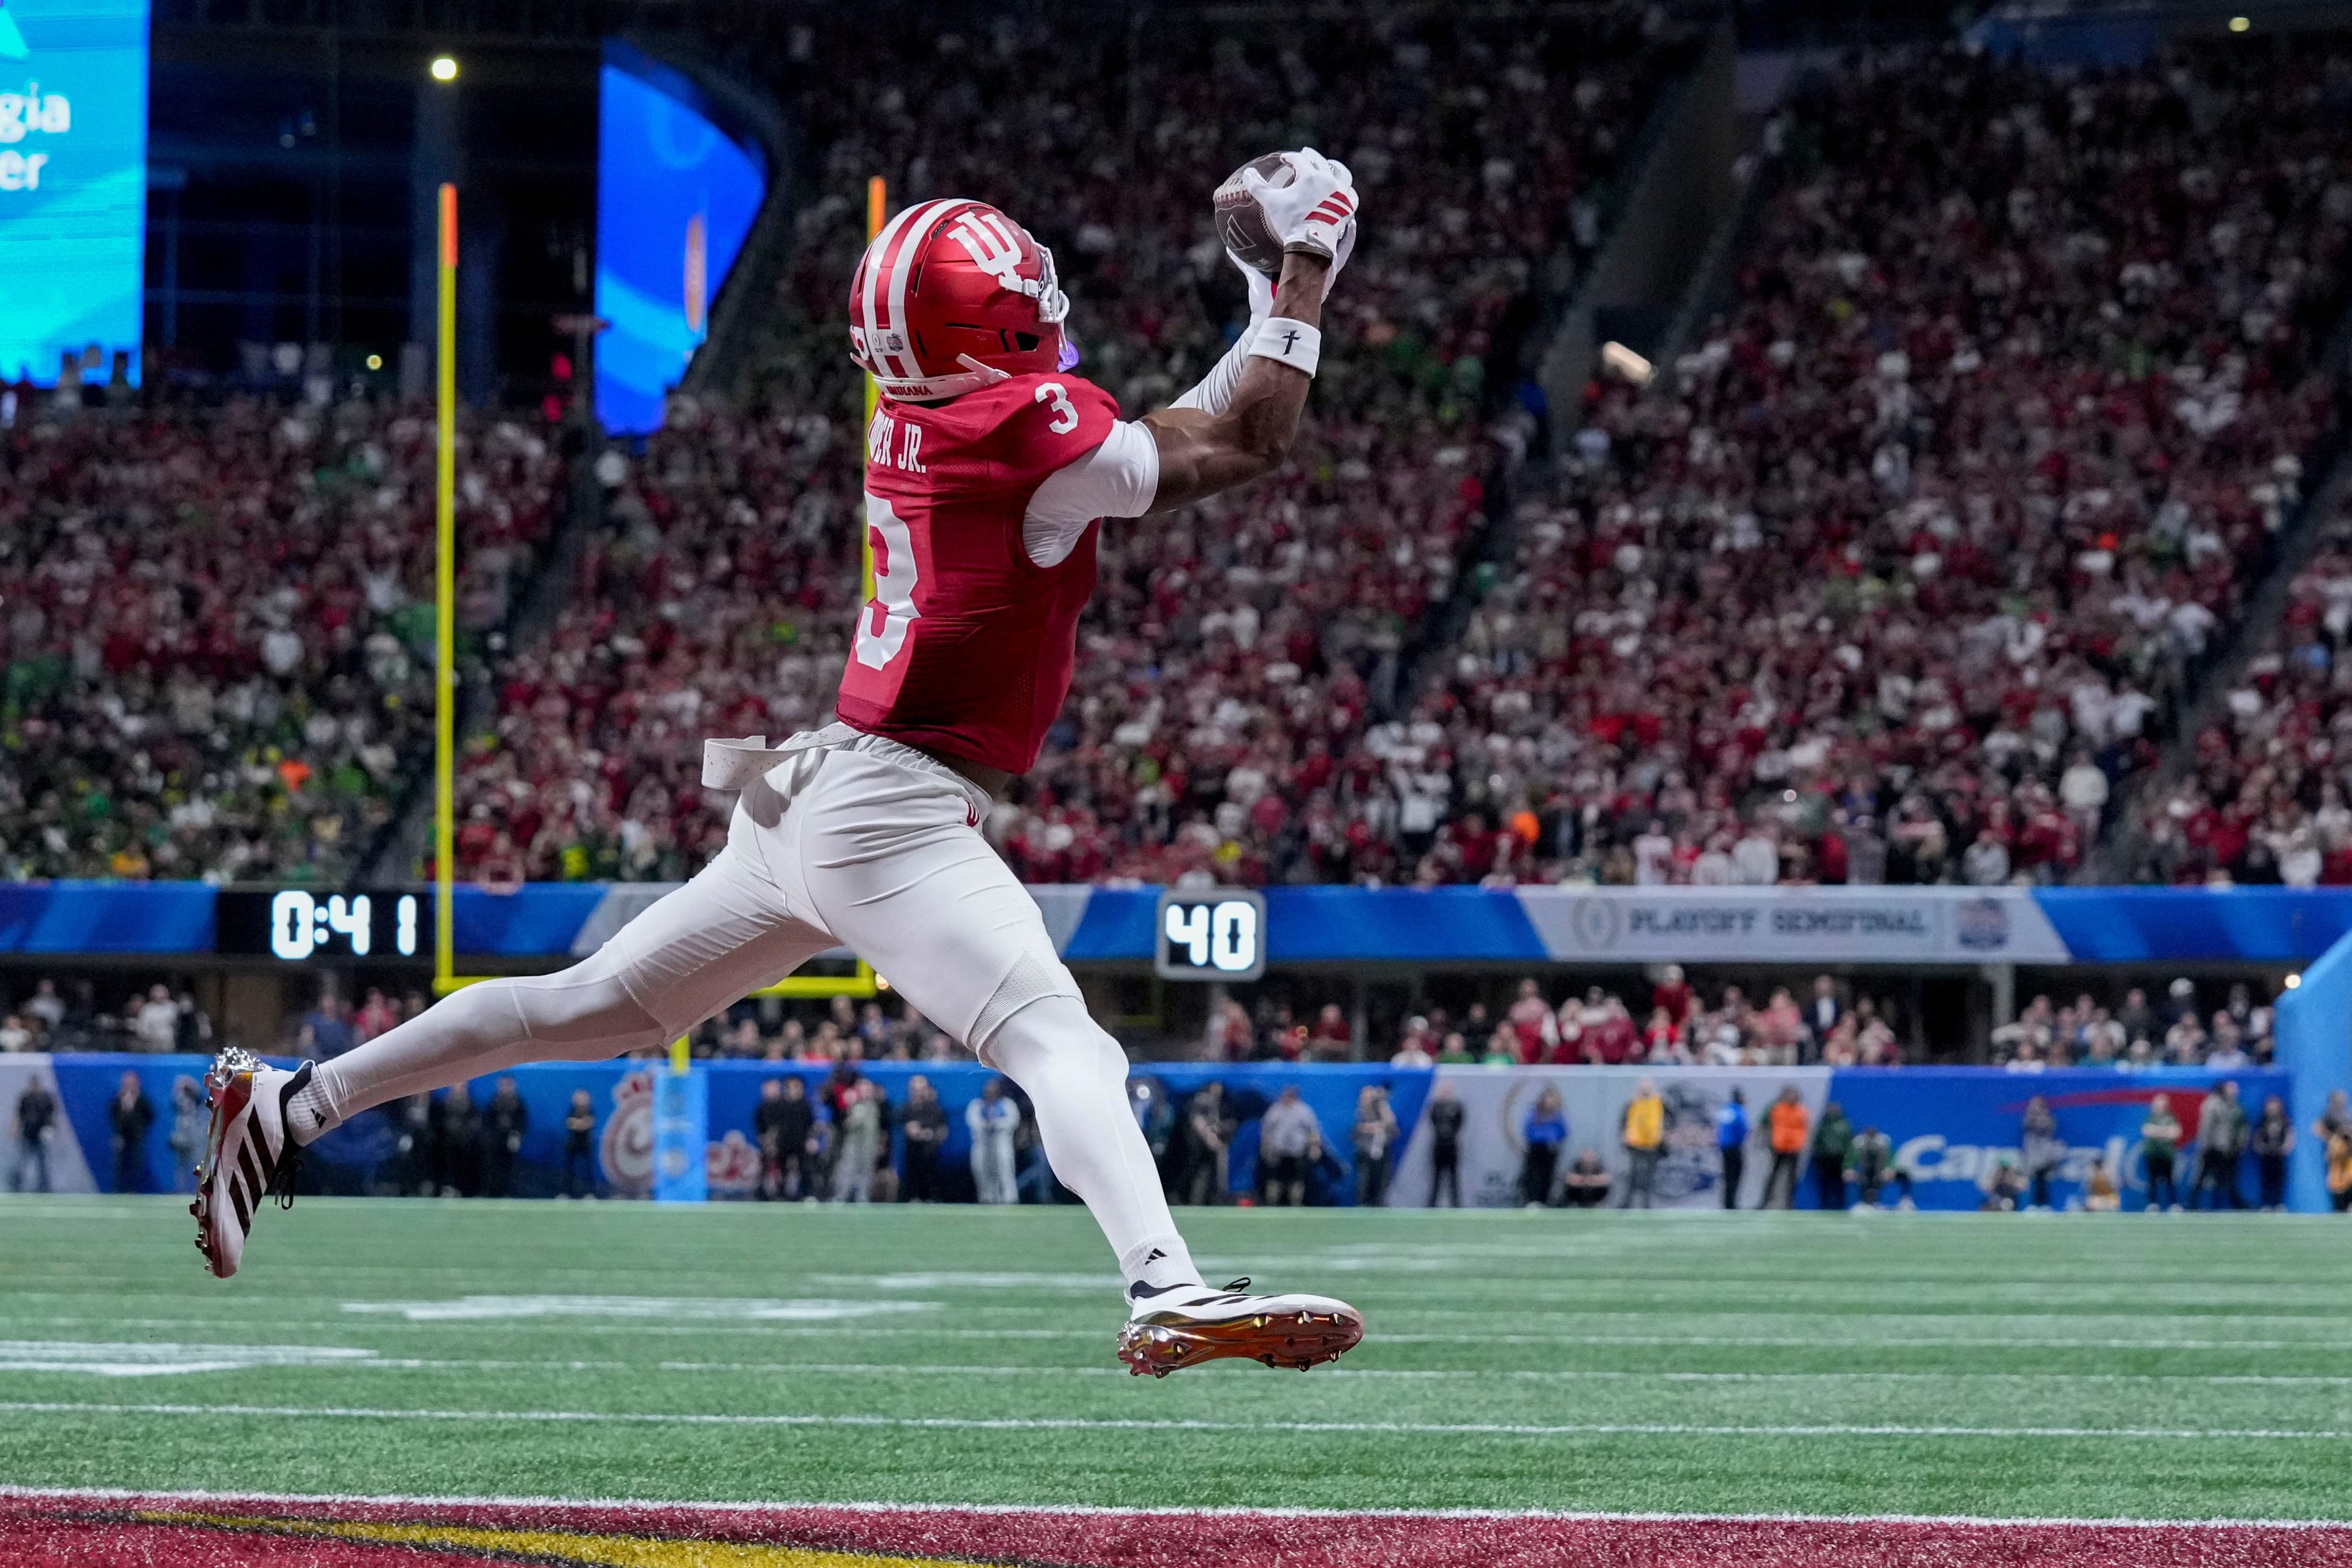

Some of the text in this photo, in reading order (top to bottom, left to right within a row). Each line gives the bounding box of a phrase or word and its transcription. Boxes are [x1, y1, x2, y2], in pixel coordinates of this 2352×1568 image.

[885, 385, 933, 396] INDIANA
[1035, 382, 1079, 434] 3
[897, 423, 926, 473] JR.
[856, 490, 921, 671] 3
[272, 891, 417, 960] 0:41
[1166, 901, 1256, 970] 40
